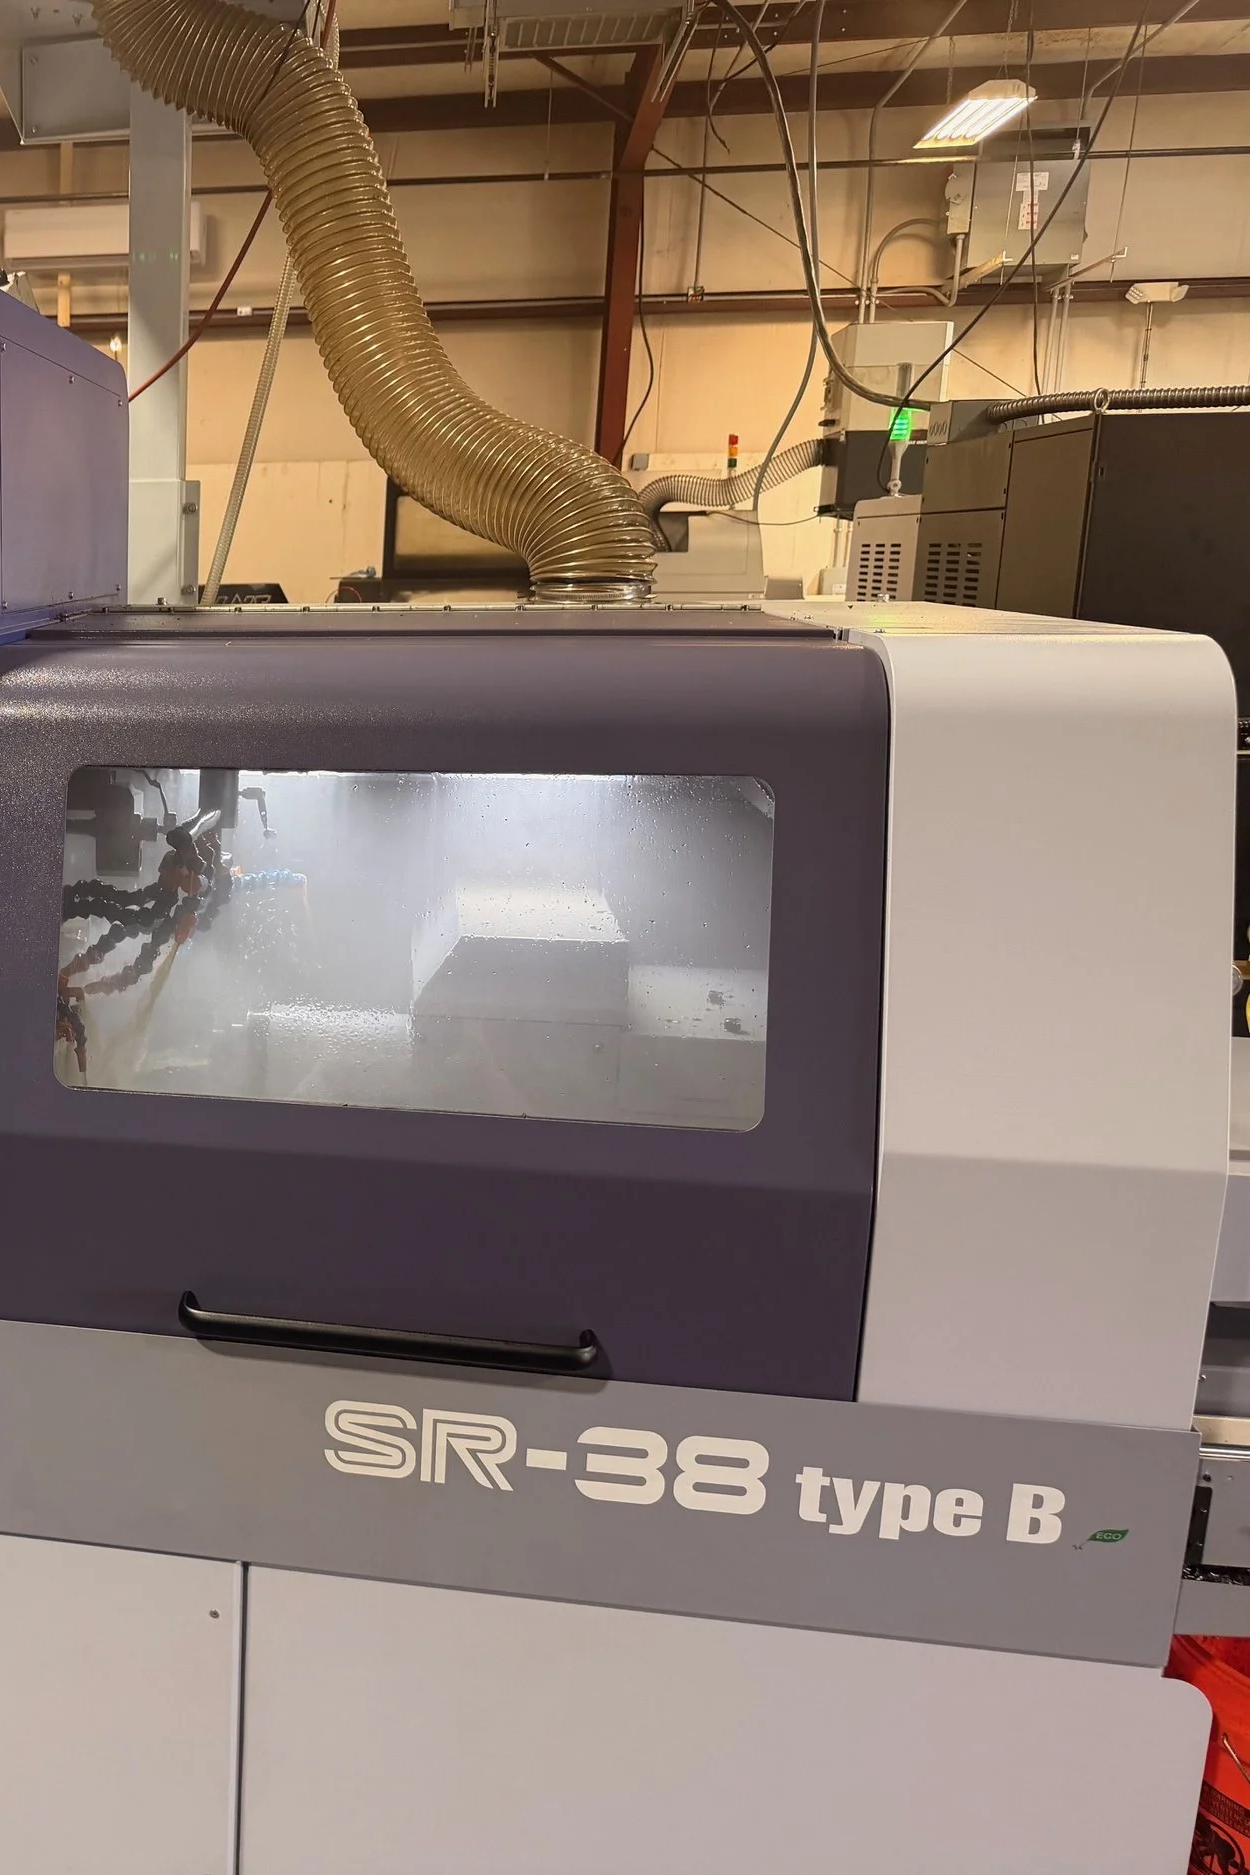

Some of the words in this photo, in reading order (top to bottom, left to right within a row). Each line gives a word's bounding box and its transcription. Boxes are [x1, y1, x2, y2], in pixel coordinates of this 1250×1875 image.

[323, 1400, 770, 1515] SR-38
[796, 1466, 984, 1541] type
[1006, 1484, 1066, 1544] B
[1096, 1532, 1122, 1540] ECO
